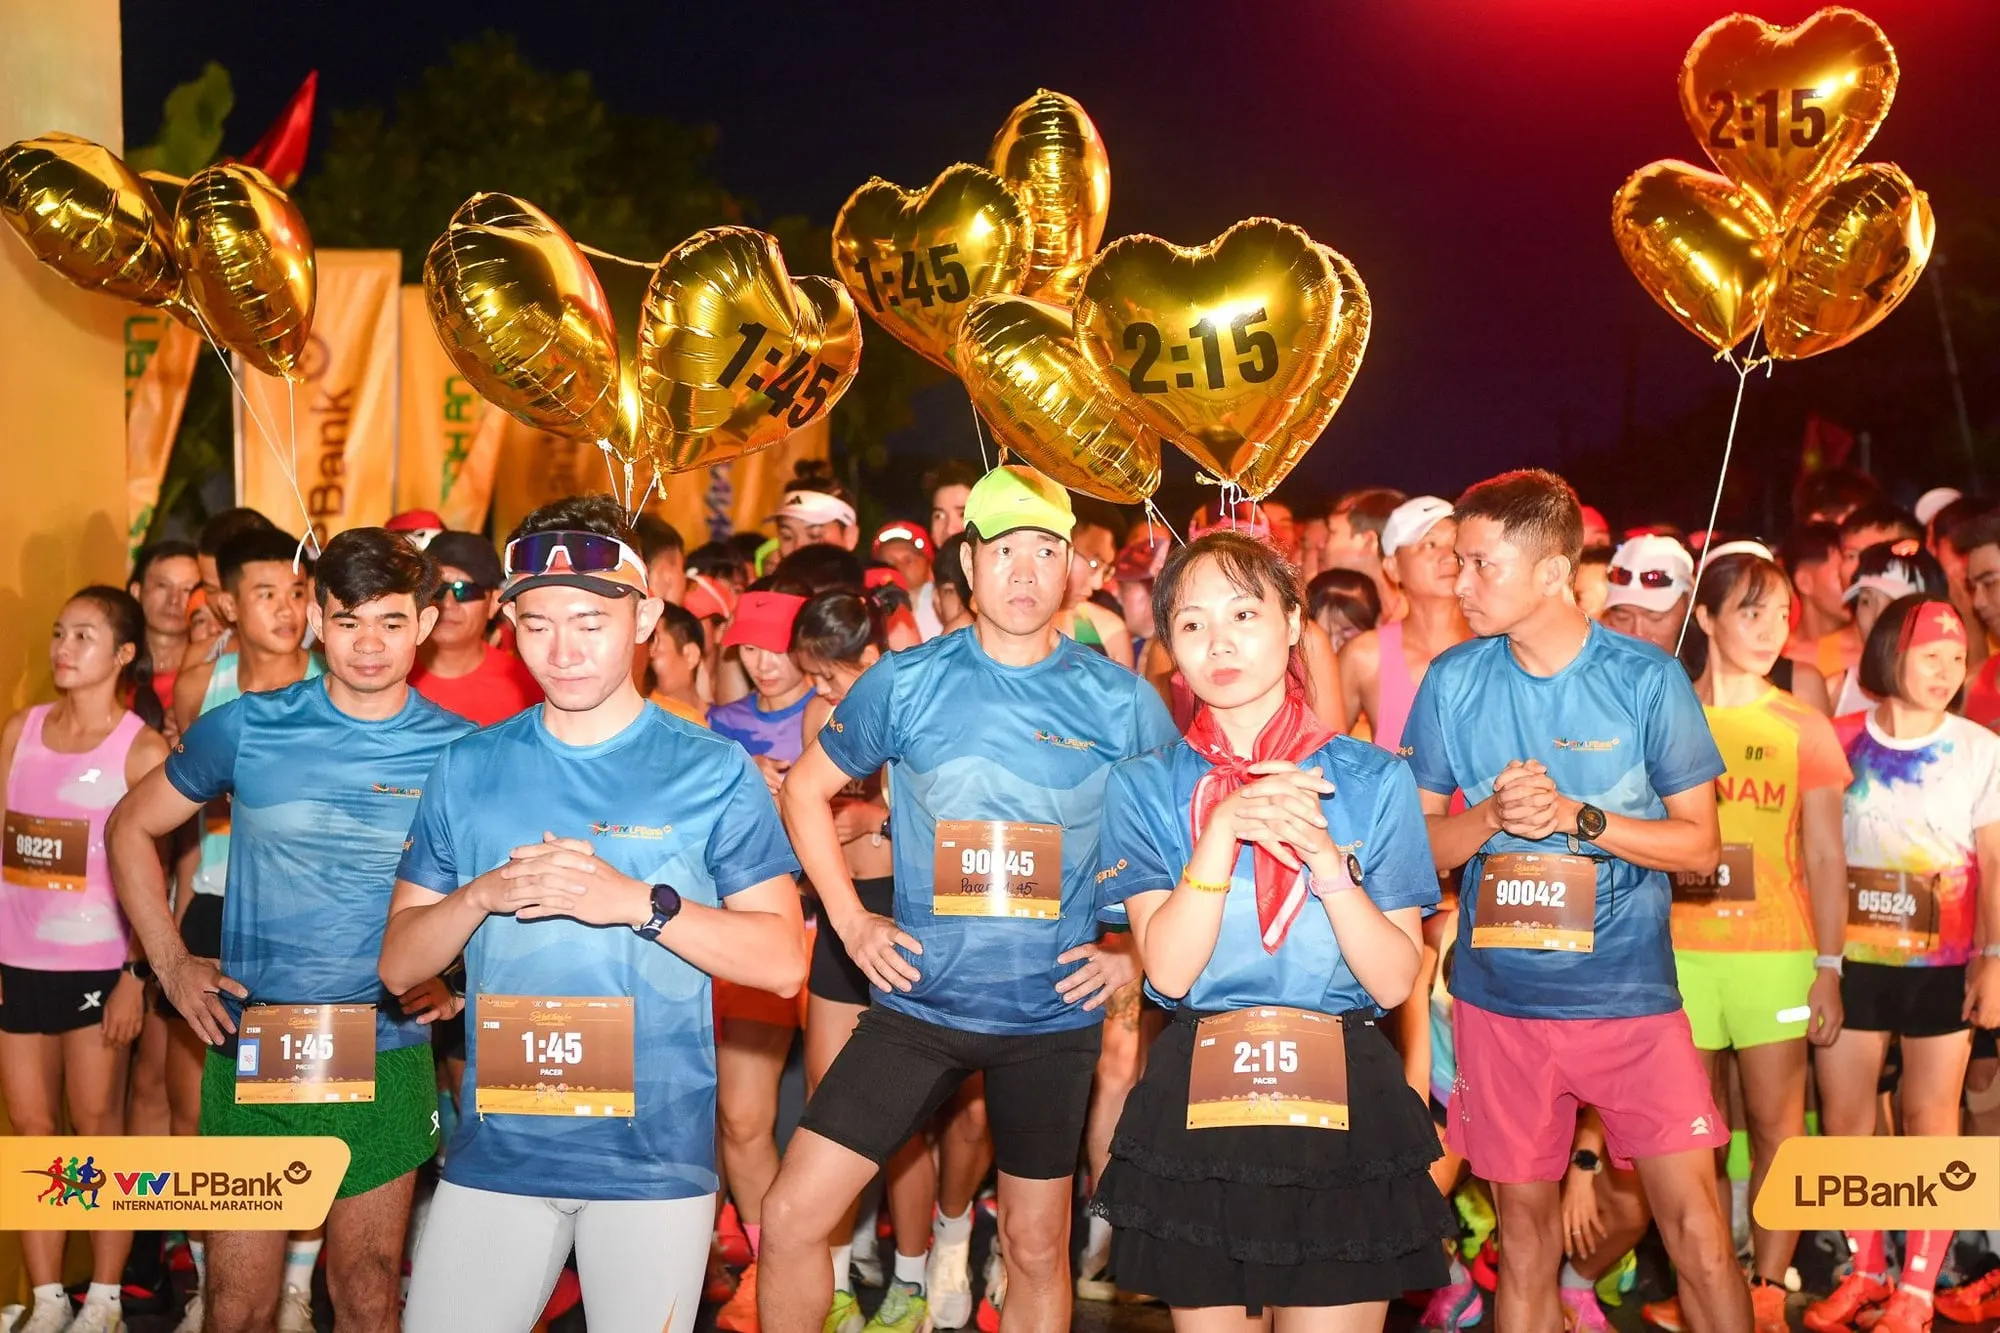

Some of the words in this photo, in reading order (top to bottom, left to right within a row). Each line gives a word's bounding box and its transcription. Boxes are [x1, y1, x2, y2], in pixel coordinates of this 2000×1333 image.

[1705, 88, 1826, 149] 2:15
[855, 242, 970, 313] 1:45
[1122, 307, 1279, 394] 2:15
[716, 322, 839, 429] 1:45
[17, 833, 63, 860] 98221
[1496, 879, 1566, 908] 90042
[1858, 888, 1917, 917] 95524
[280, 1033, 334, 1061] 1:45
[521, 1031, 583, 1065] 1:45
[1233, 1040, 1298, 1074] 2:15
[540, 1068, 563, 1077] PACER
[1253, 1077, 1278, 1085] PACER
